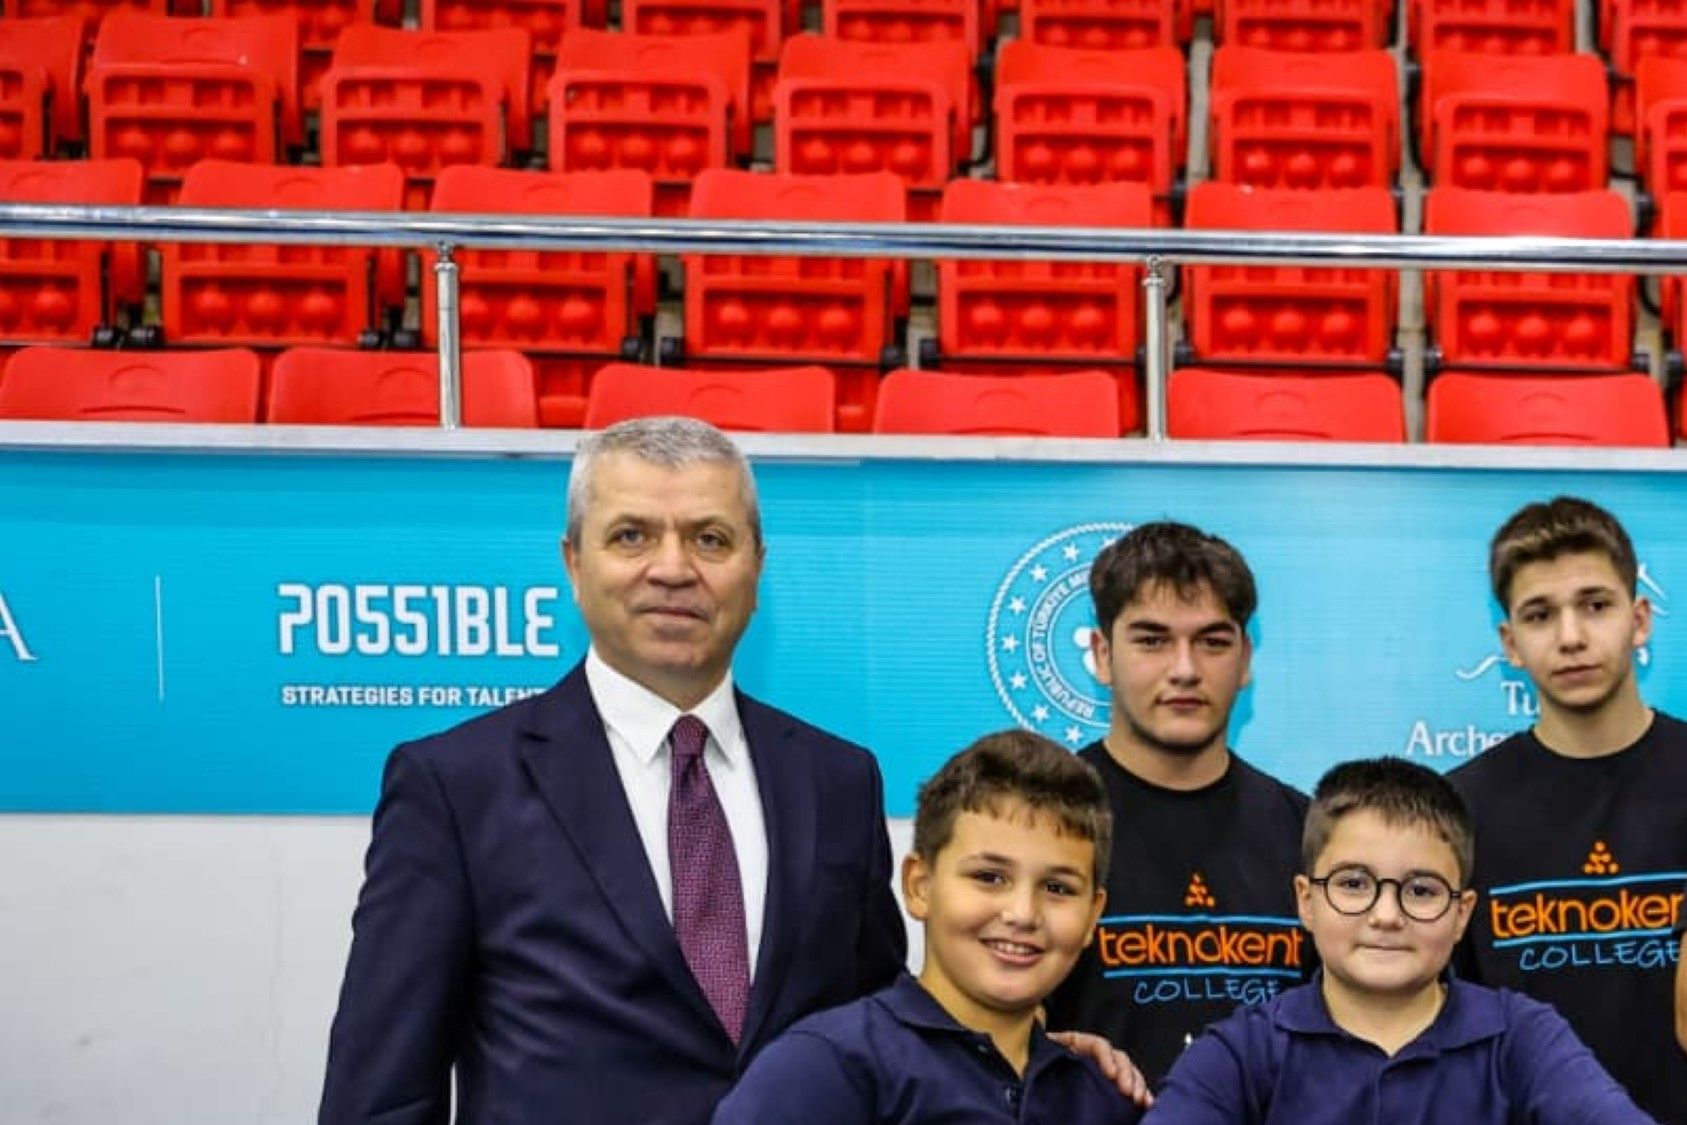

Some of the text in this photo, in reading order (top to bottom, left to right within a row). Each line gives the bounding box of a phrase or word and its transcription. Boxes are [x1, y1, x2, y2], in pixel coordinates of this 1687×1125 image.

[282, 686, 413, 707] STRATEGIES
[418, 687, 462, 707] FOR
[1406, 720, 1511, 757] Arche
[1099, 923, 1303, 968] teknokent
